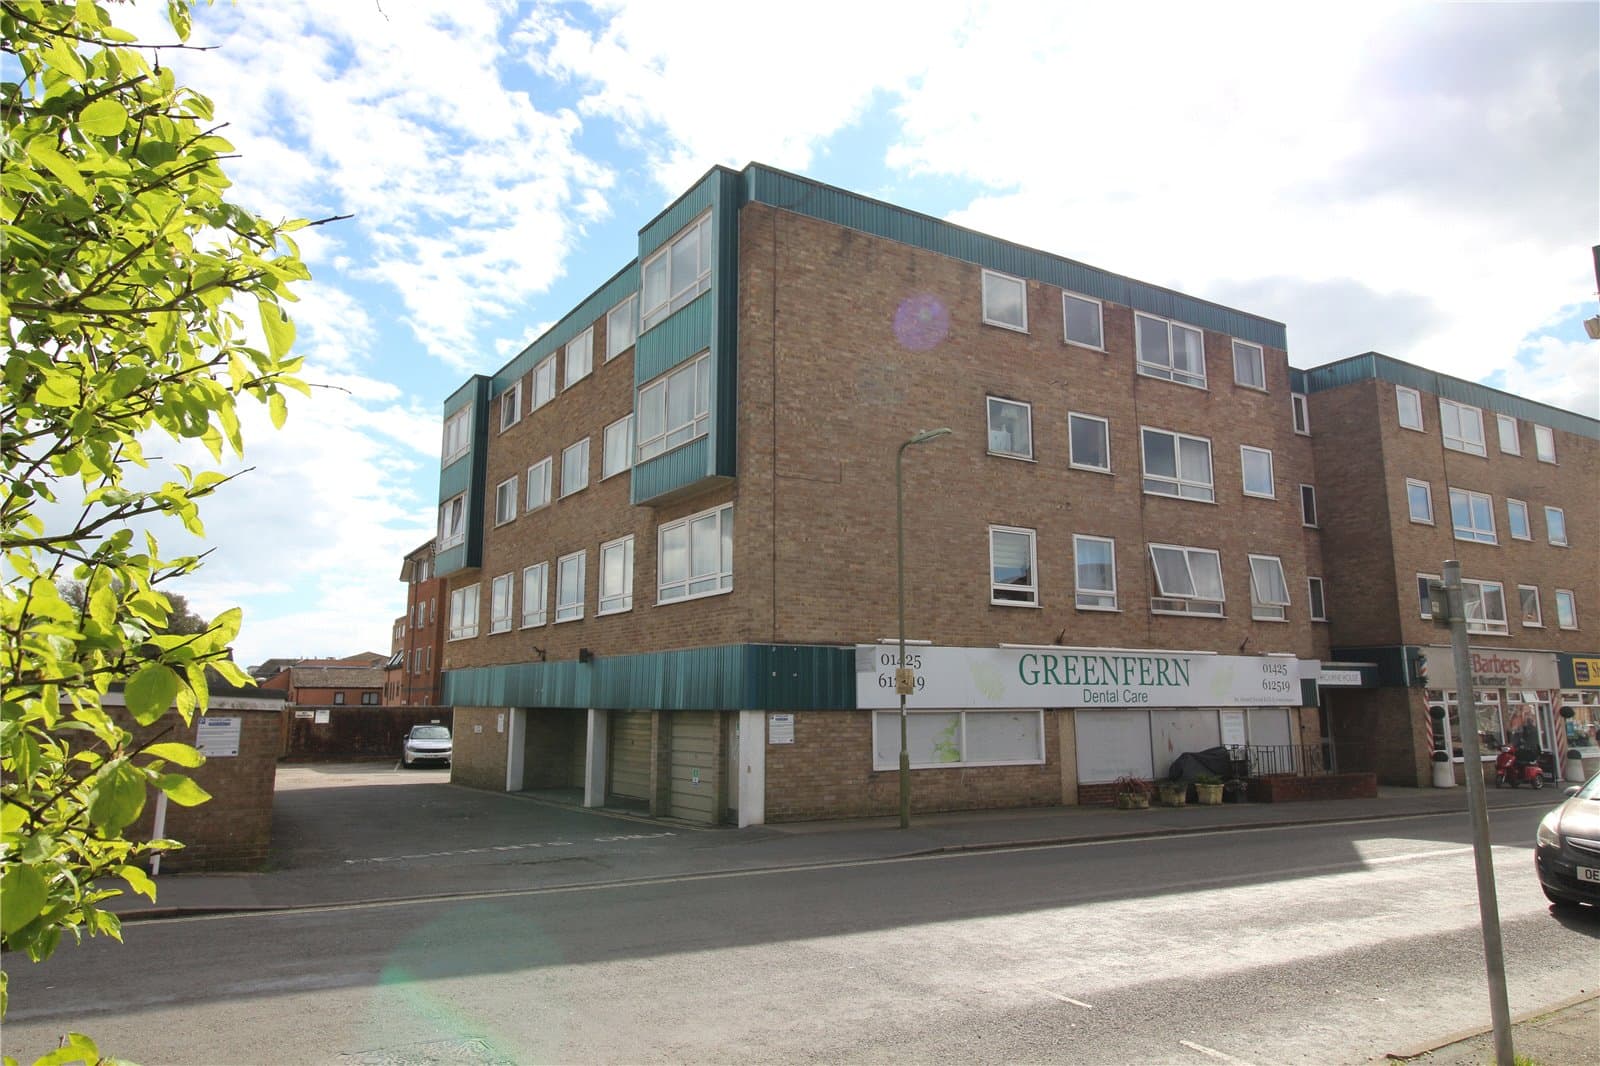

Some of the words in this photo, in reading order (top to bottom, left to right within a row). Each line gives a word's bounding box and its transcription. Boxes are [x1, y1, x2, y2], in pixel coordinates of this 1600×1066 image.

[1018, 653, 1191, 687] GREENFERN
[1262, 664, 1288, 676] 01425
[1472, 654, 1521, 674] Barbers
[878, 673, 925, 691] 6119
[1262, 679, 1290, 692] 612519
[1083, 689, 1119, 703] Dental
[1123, 689, 1149, 703] Care
